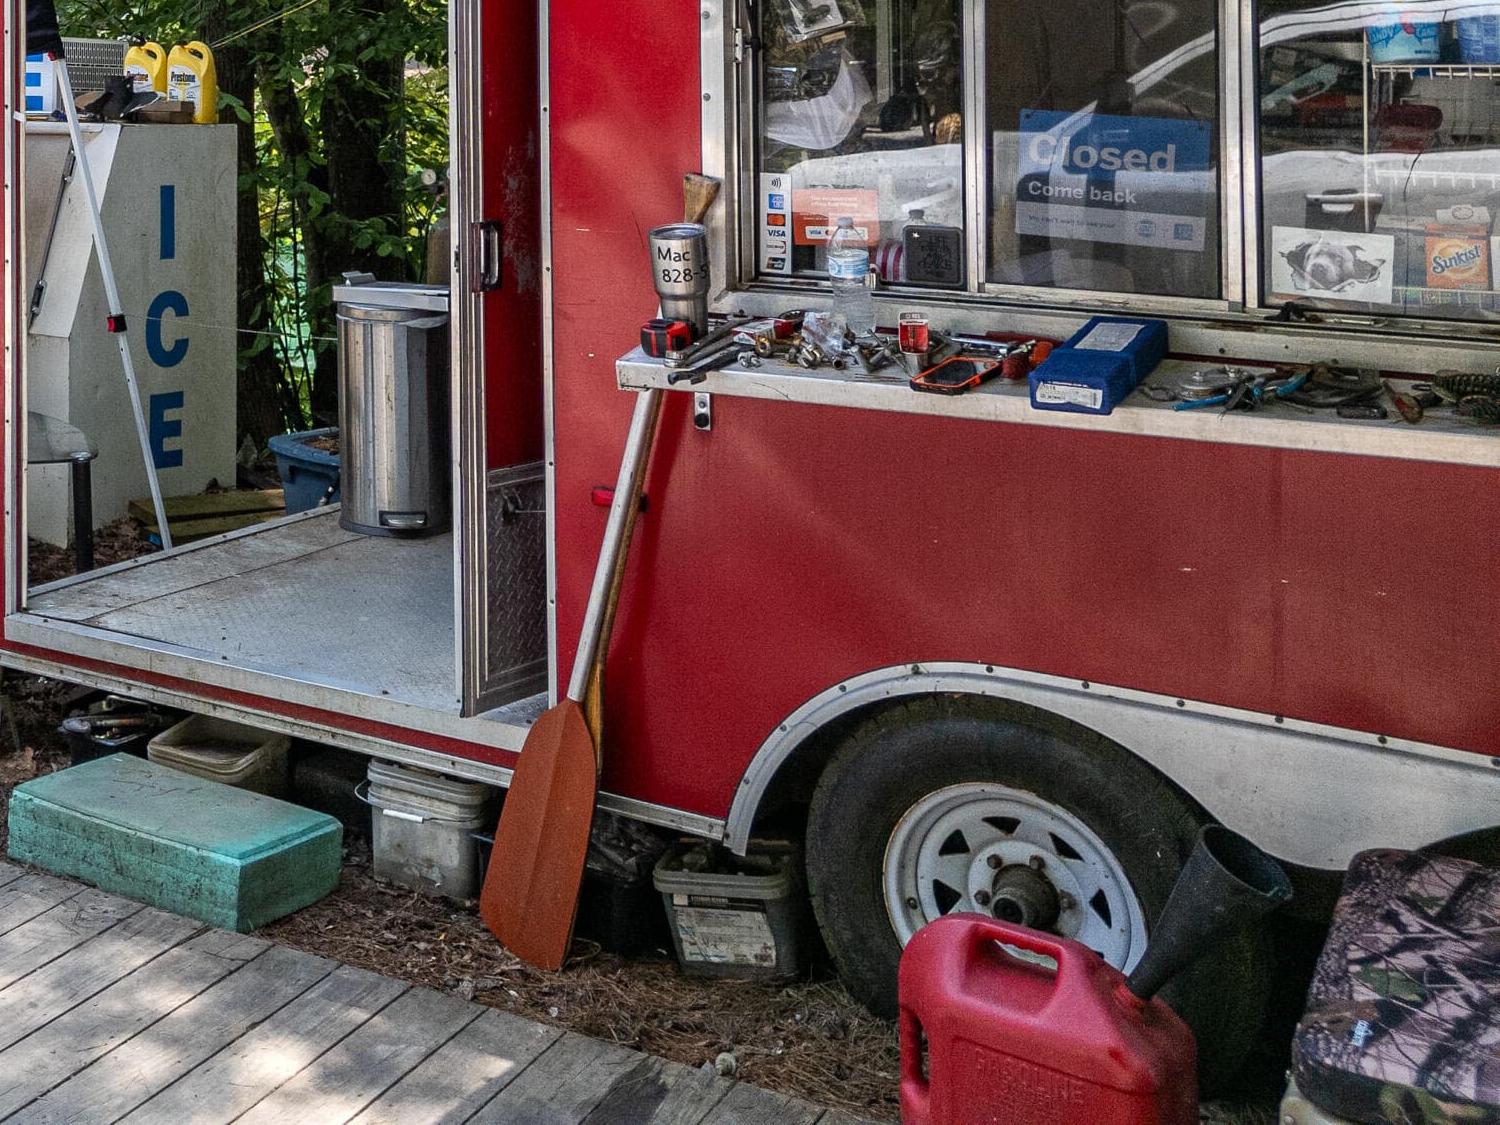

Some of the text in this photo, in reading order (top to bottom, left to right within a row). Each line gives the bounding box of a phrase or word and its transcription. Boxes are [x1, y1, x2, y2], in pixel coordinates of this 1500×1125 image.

[170, 71, 196, 83] Prestone
[1028, 133, 1177, 173] Closed
[1028, 180, 1137, 204] Come back
[767, 229, 786, 237] VISA
[657, 246, 691, 262] Mac
[1432, 244, 1482, 274] Sunkist
[144, 185, 190, 470] ICE
